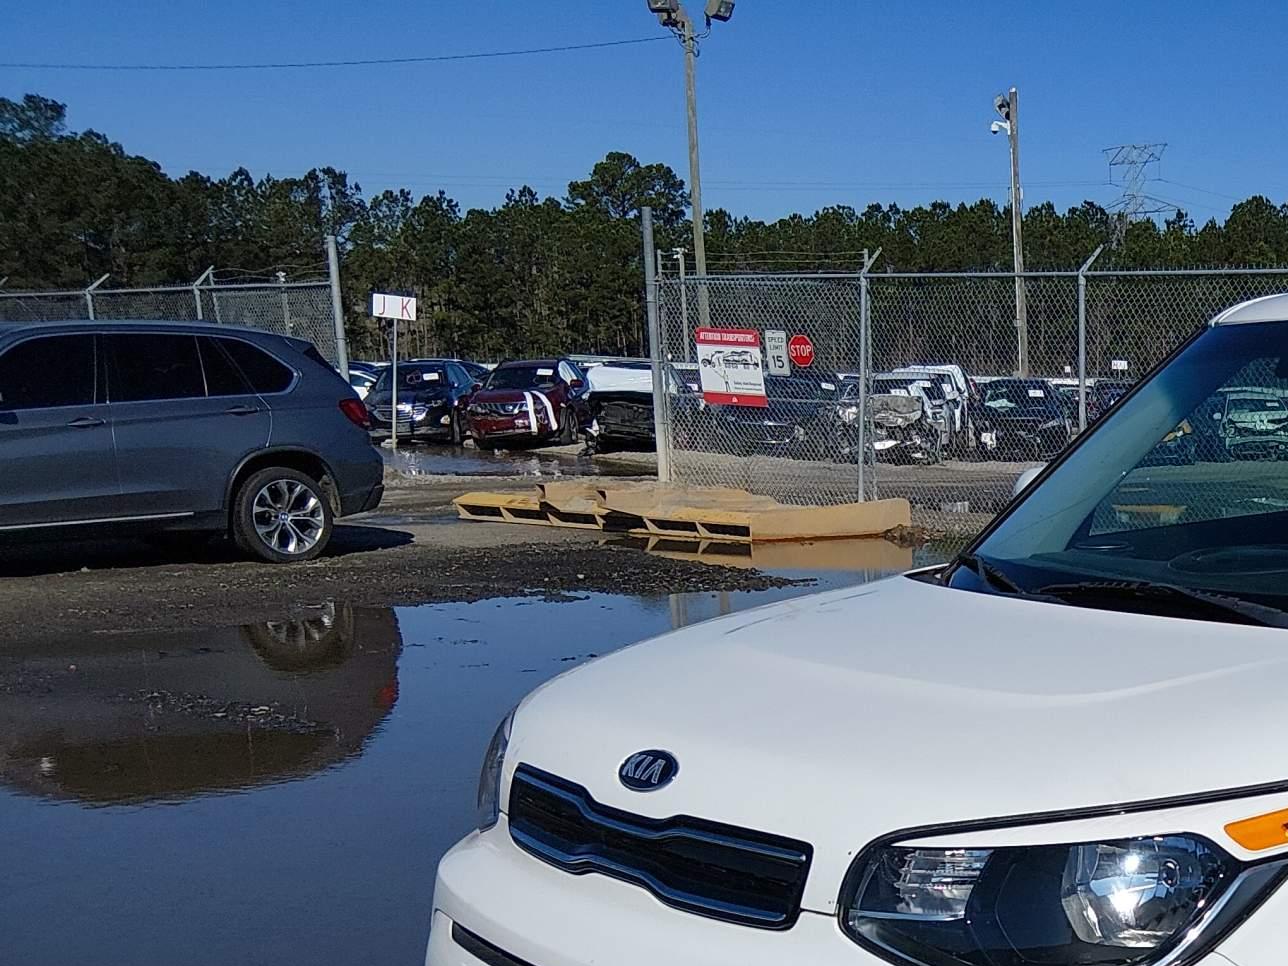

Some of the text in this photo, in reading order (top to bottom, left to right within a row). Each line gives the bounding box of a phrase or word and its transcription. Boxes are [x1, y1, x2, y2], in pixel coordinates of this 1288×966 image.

[378, 295, 412, 319] J K
[790, 344, 812, 357] STOP
[771, 354, 785, 369] 15
[621, 753, 667, 785] KIA
